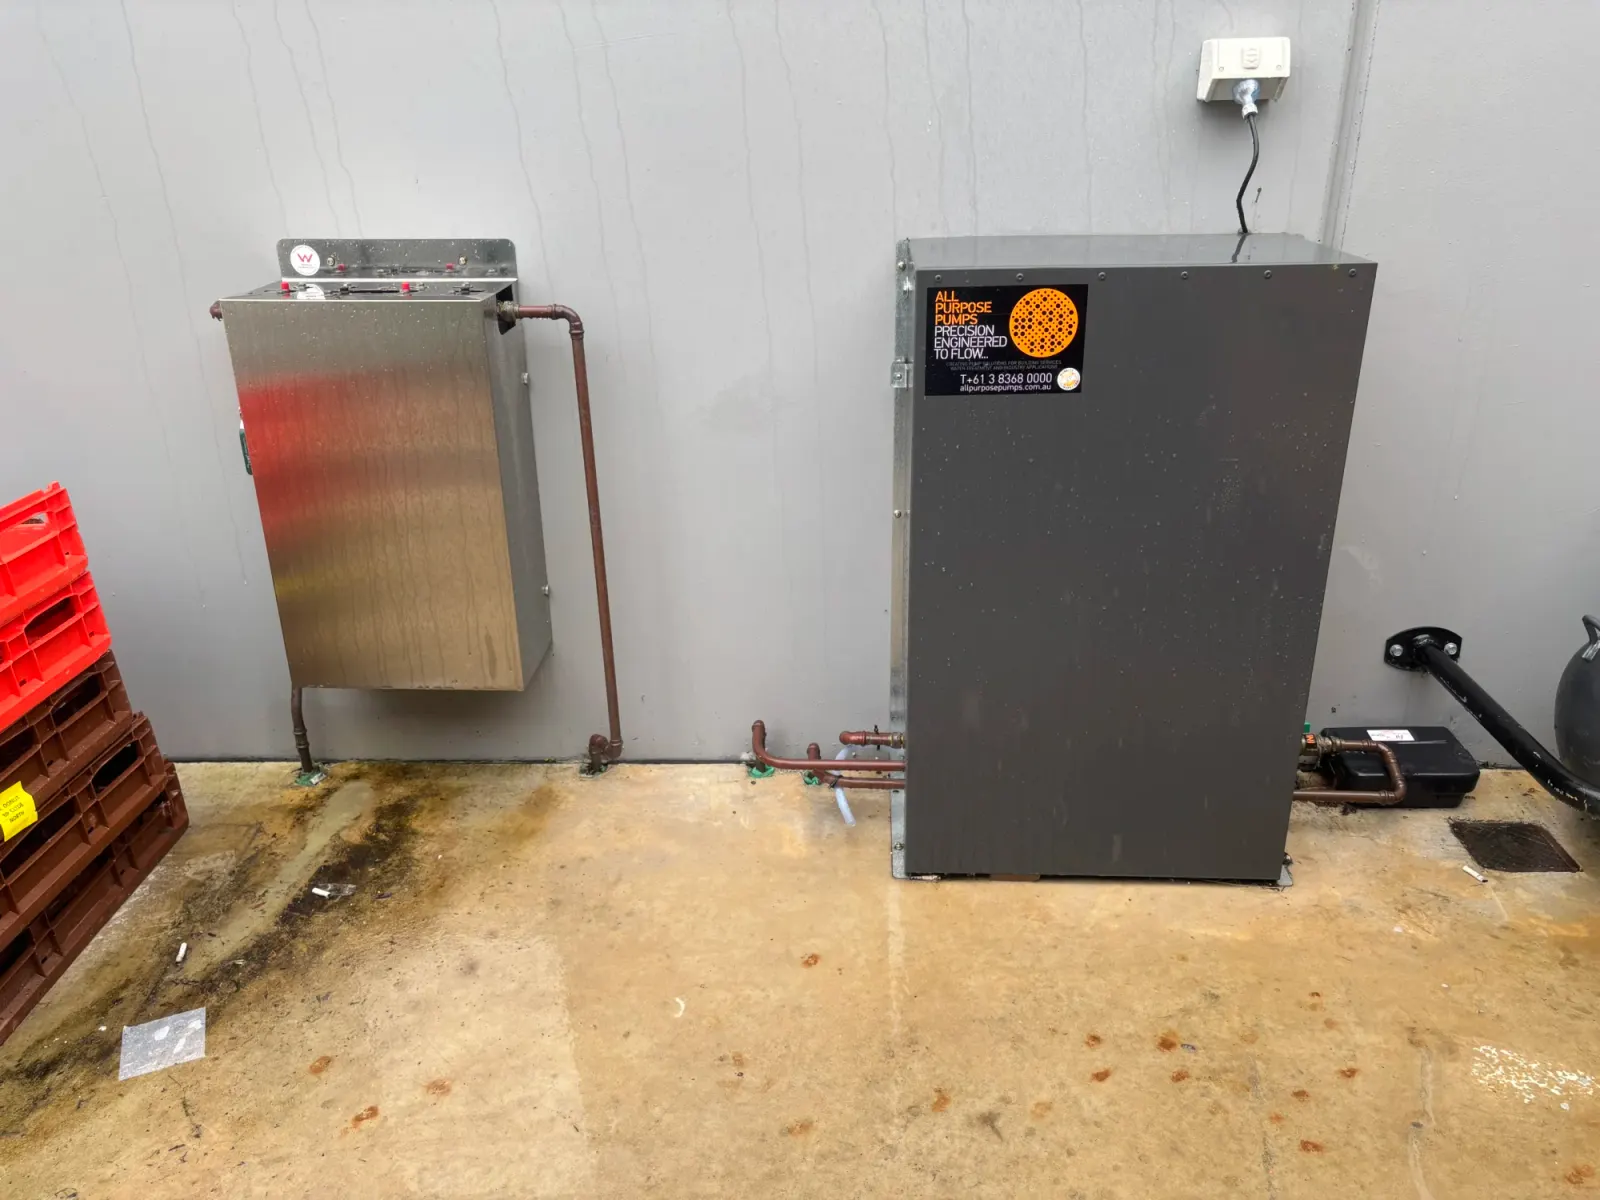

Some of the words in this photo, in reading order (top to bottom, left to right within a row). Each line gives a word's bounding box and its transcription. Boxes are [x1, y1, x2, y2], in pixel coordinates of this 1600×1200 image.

[935, 290, 959, 302] ALL
[935, 301, 993, 314] PURPOSE
[935, 313, 978, 326] PUMPS
[934, 324, 995, 337] PRECISION
[934, 336, 1008, 349] ENGINEERED
[933, 348, 949, 360] TO
[950, 347, 989, 360] FLOW...
[960, 373, 985, 385] T+61
[988, 373, 995, 384] 3
[997, 373, 1024, 384] 8368
[1026, 372, 1053, 384] 0000
[960, 384, 1052, 393] allpurposepumps.com.au
